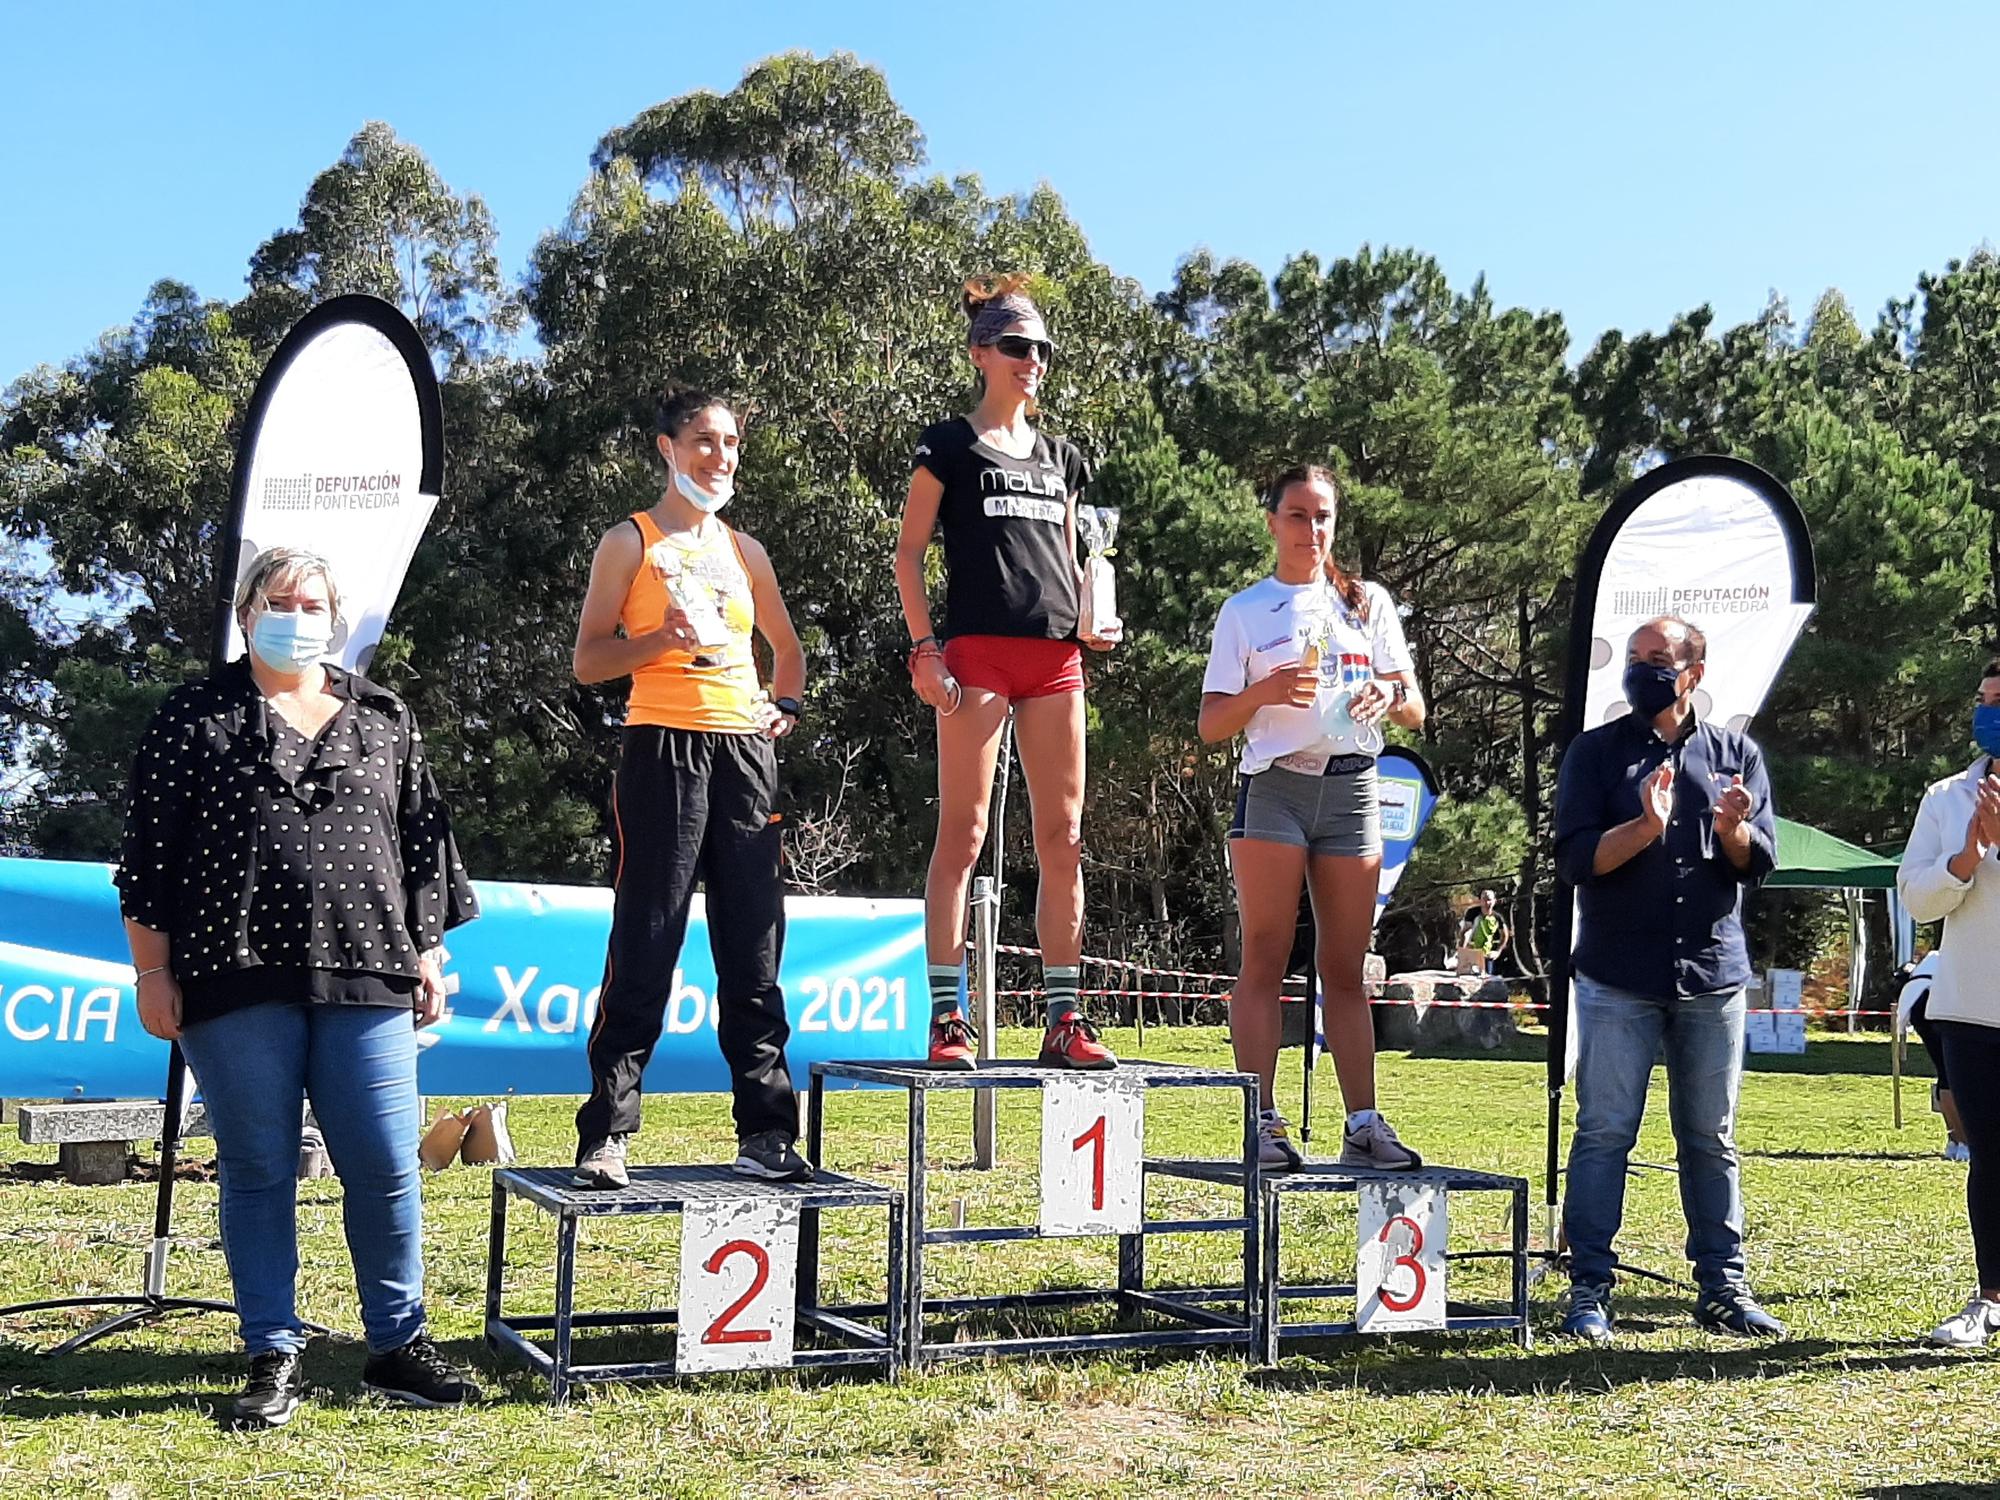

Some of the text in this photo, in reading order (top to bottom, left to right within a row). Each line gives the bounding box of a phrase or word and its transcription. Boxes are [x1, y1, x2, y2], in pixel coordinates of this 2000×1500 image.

[314, 492, 400, 511] PONTEVEDRA
[315, 470, 400, 493] DEPUTACIÓN
[1672, 584, 1770, 602] DEPUTACIÓN
[1672, 600, 1769, 615] PONTEVEDRA
[0, 984, 121, 1043] CIA
[798, 975, 907, 1033] 2021
[1072, 1115, 1106, 1211] 1
[701, 1239, 772, 1344] 2
[1377, 1216, 1427, 1312] 3
